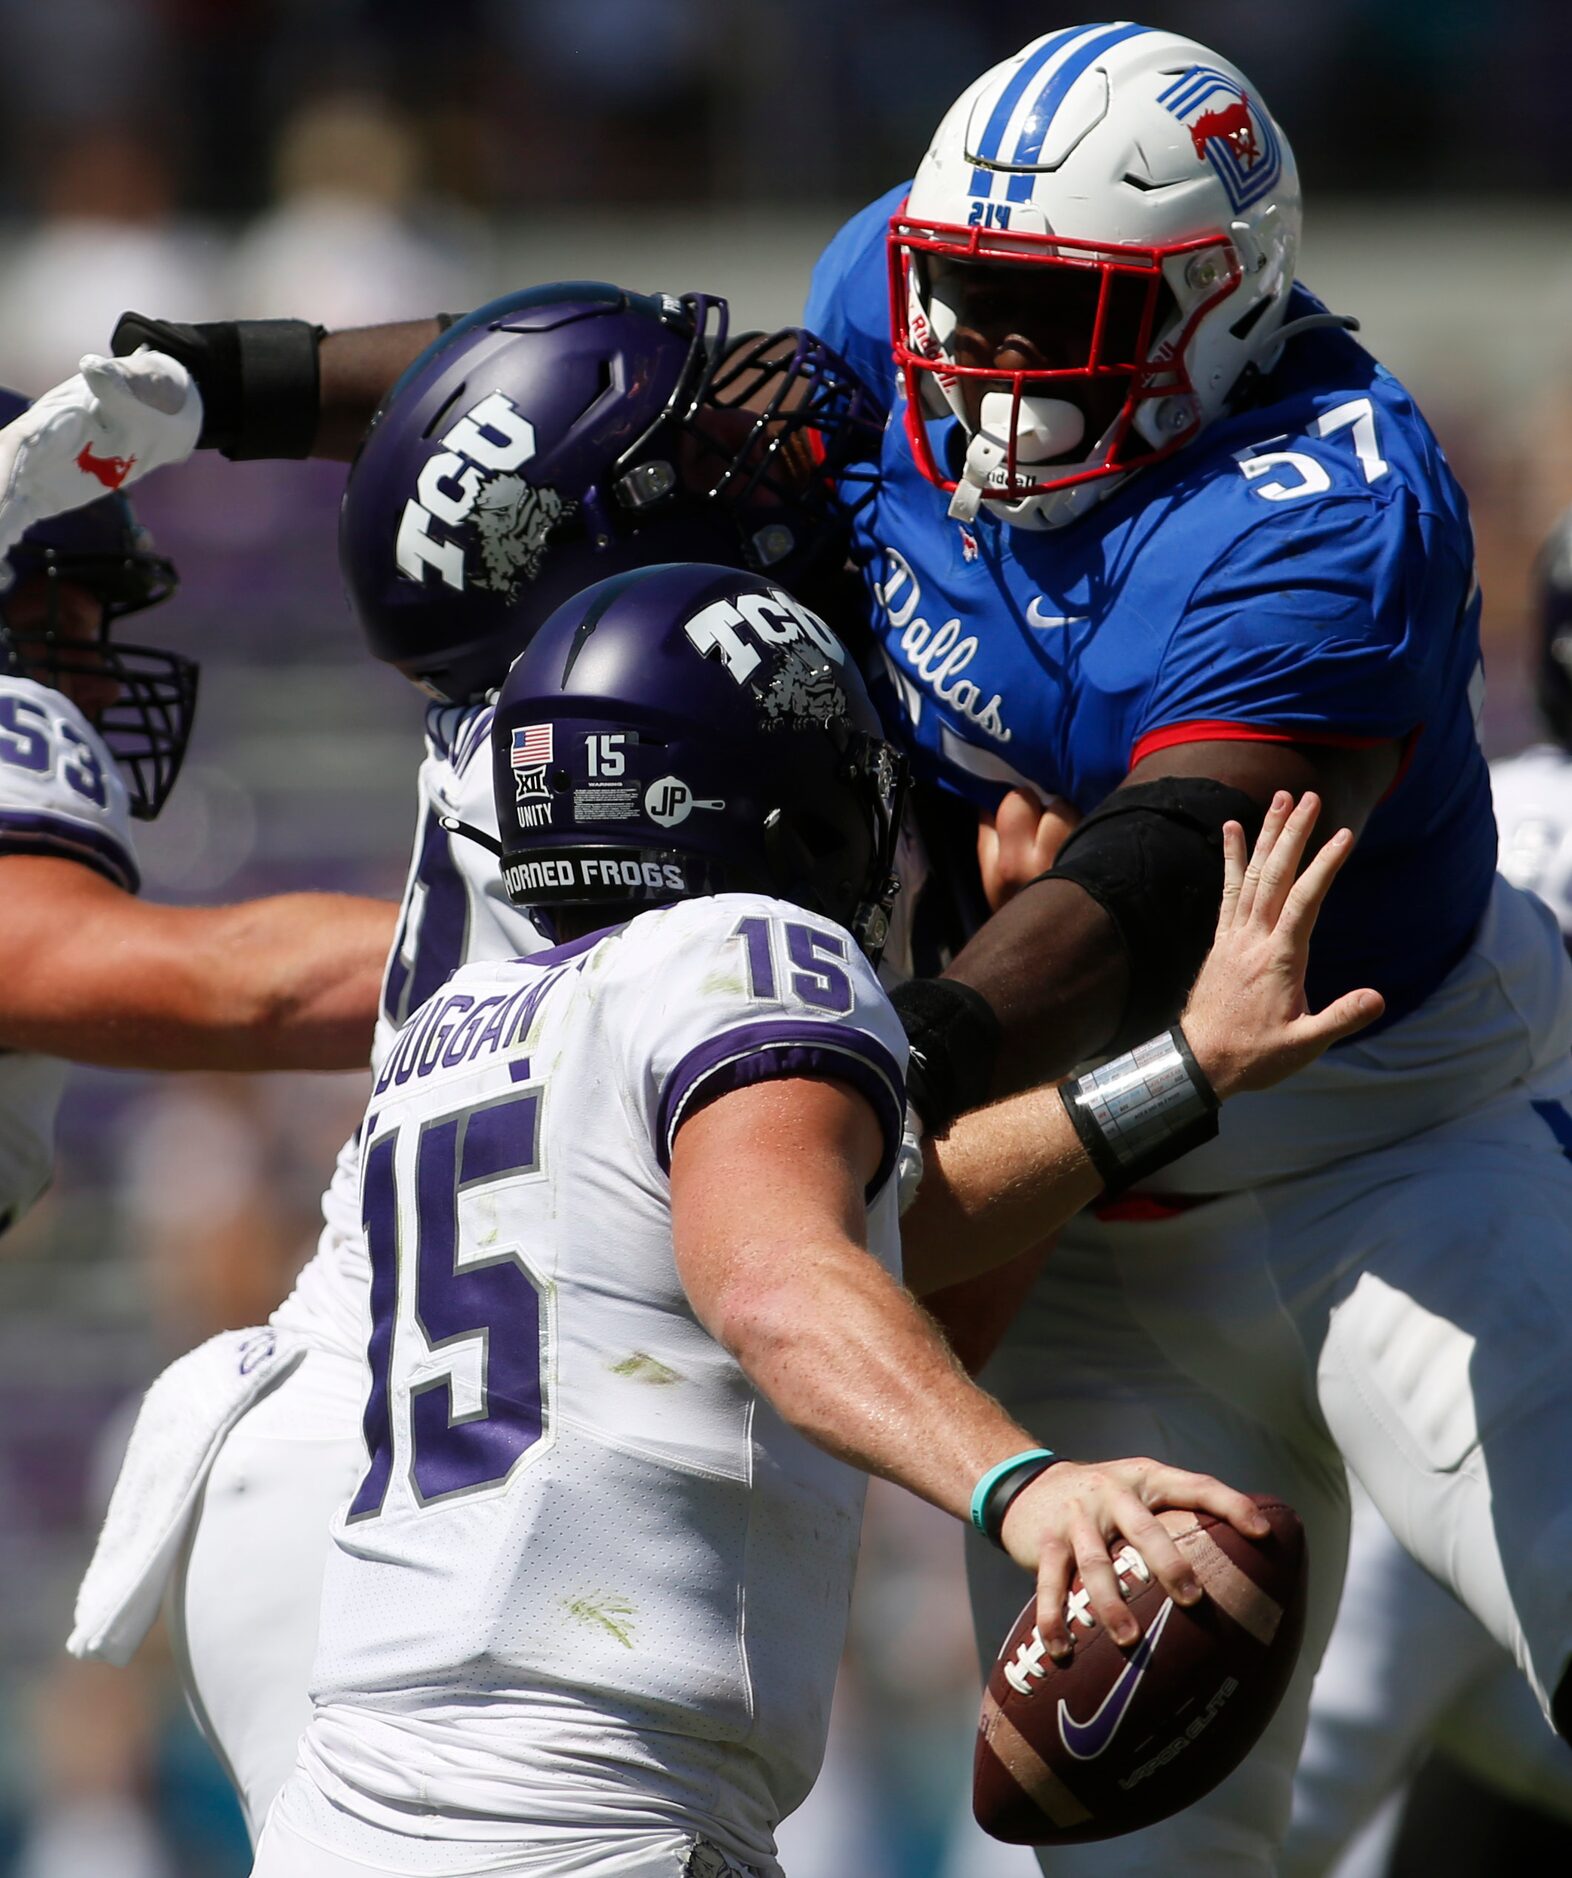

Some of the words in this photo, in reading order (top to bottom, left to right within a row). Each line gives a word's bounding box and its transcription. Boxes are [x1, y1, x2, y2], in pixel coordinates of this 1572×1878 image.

[968, 201, 1011, 230] 214
[396, 391, 537, 591] TCU
[1231, 397, 1389, 501] 57
[683, 588, 846, 686] TCU
[874, 546, 1012, 743] Dallas
[584, 734, 626, 777] 15
[650, 786, 687, 817] JP
[516, 802, 553, 829] UNITY
[502, 860, 575, 895] HORNED
[580, 860, 686, 890] FROGS
[734, 914, 857, 1017] 15
[346, 1084, 551, 1527] 15
